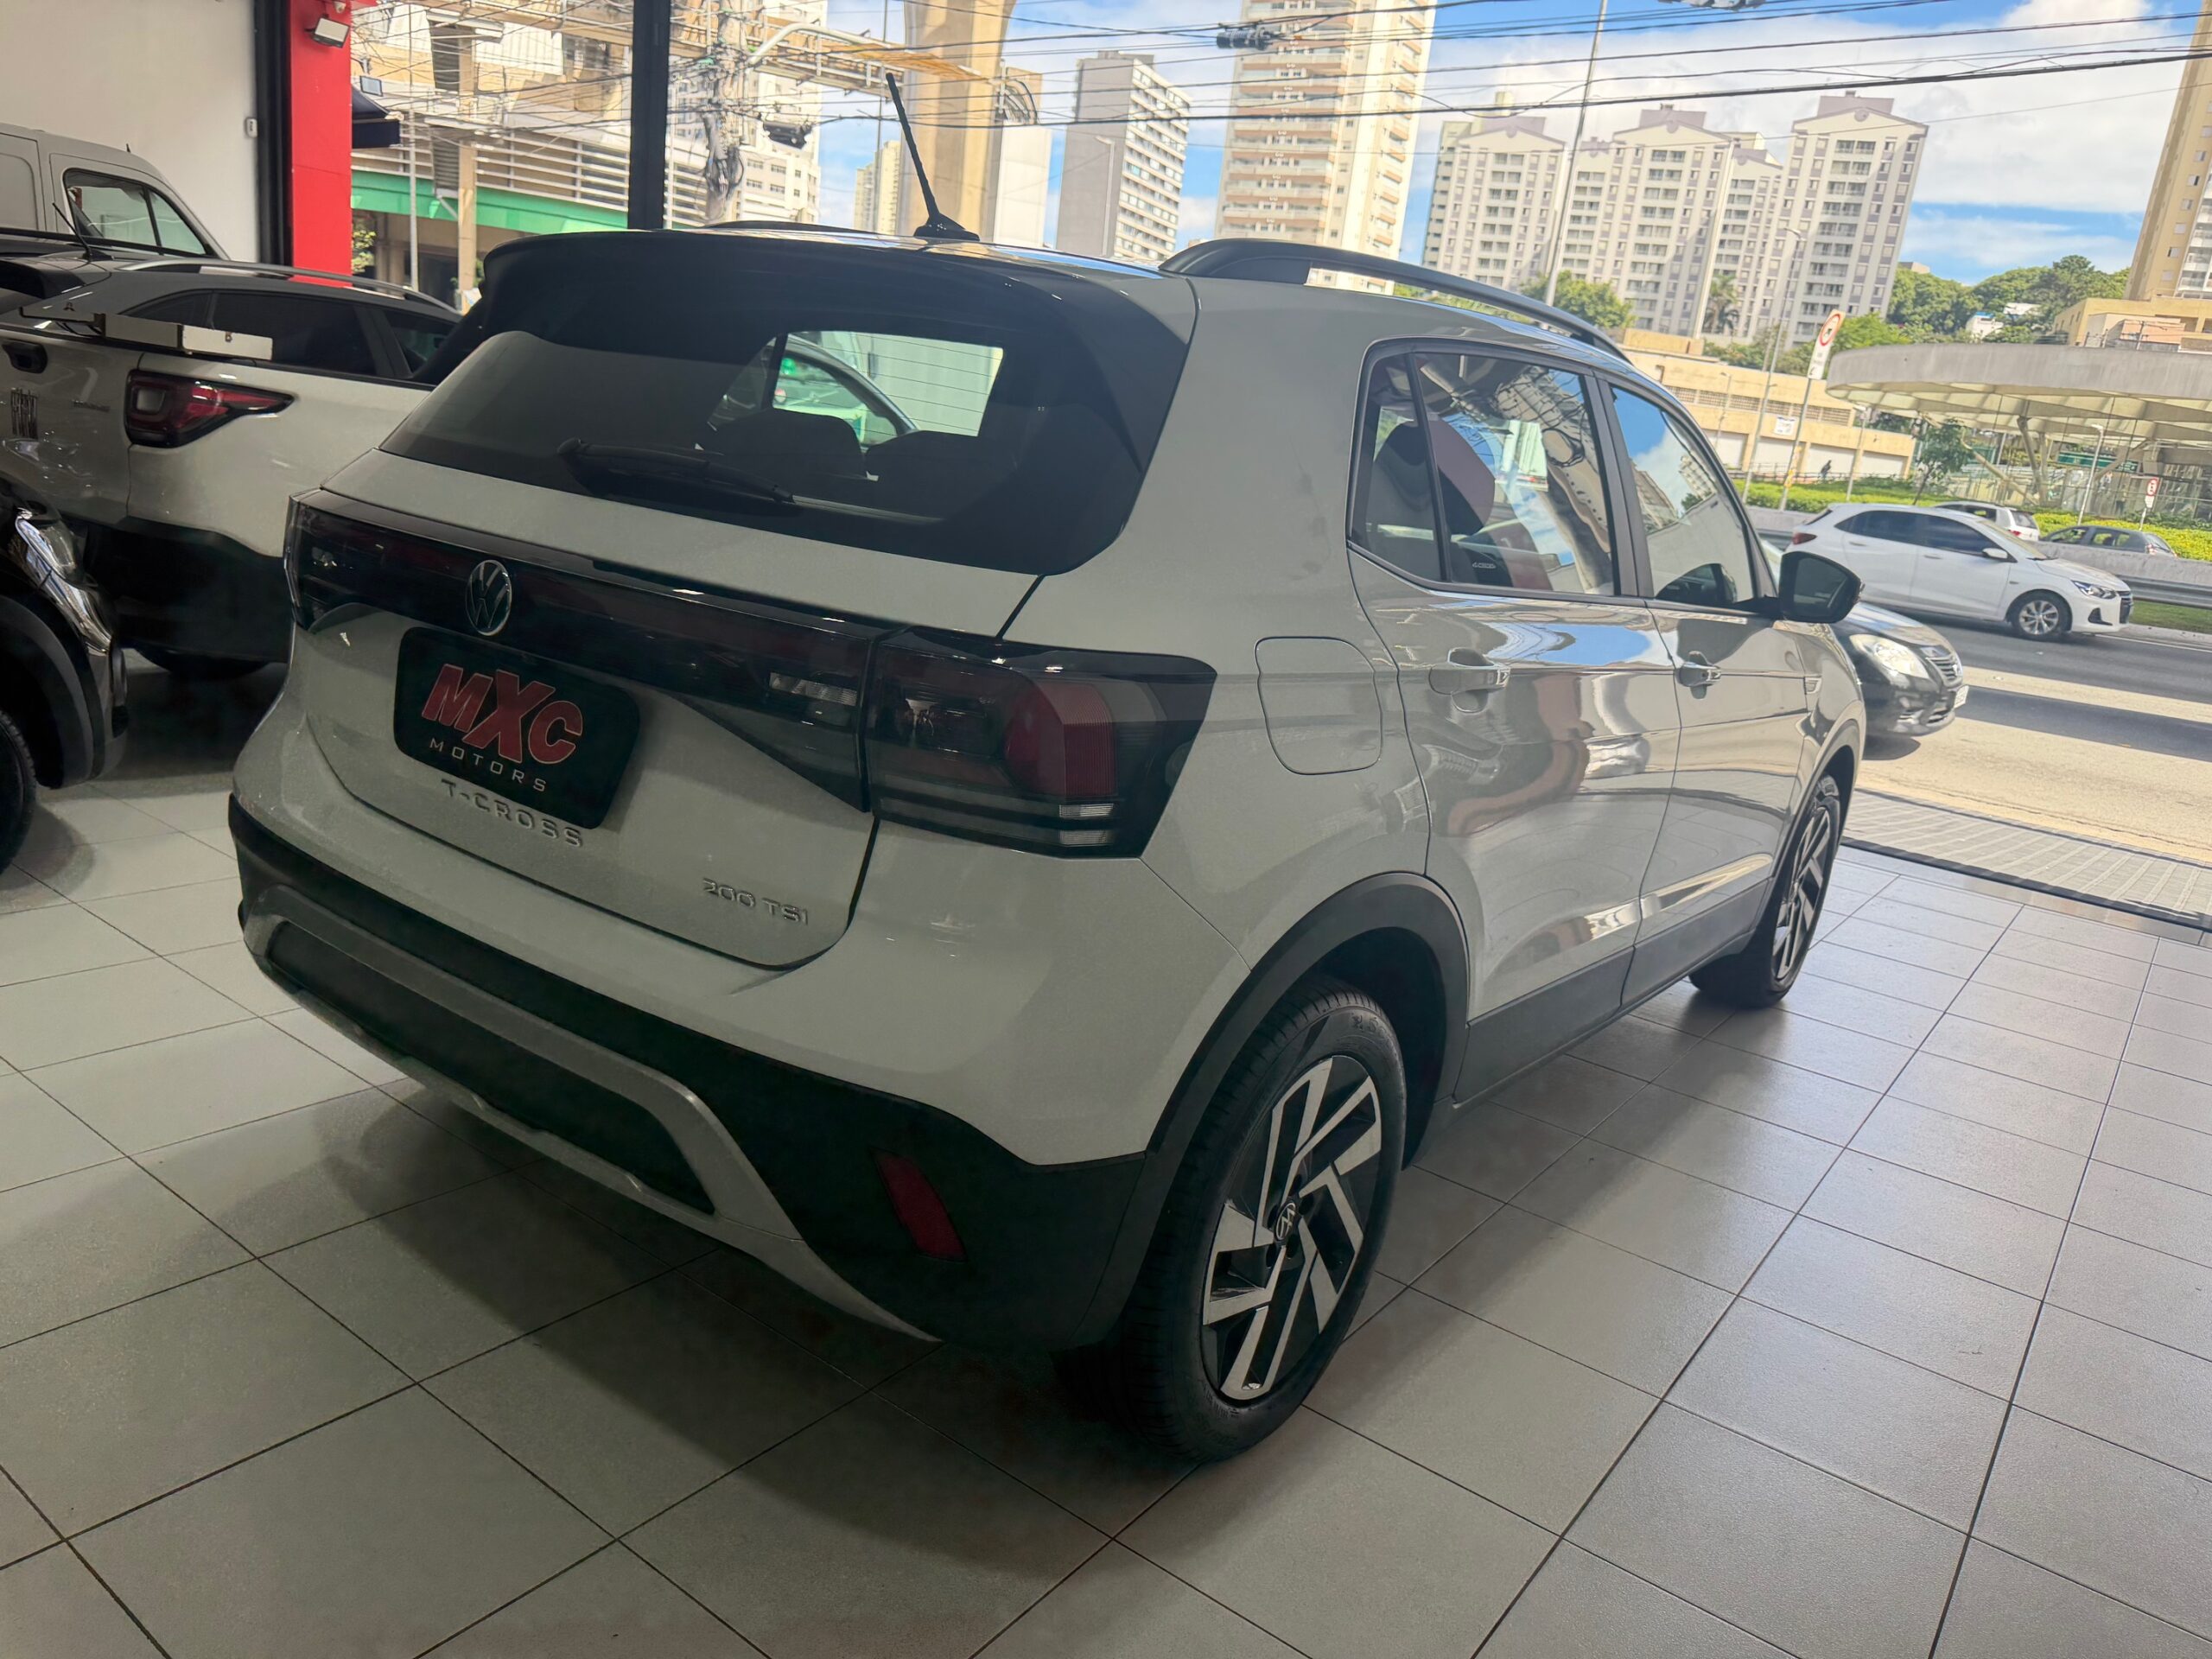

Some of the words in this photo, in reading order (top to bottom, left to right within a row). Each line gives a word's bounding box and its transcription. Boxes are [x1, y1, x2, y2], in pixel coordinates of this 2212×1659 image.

[422, 664, 583, 764] MXC
[429, 738, 547, 791] MOTORS
[442, 779, 582, 848] T-CROSS
[702, 877, 756, 907] 200
[761, 898, 808, 925] TSI
